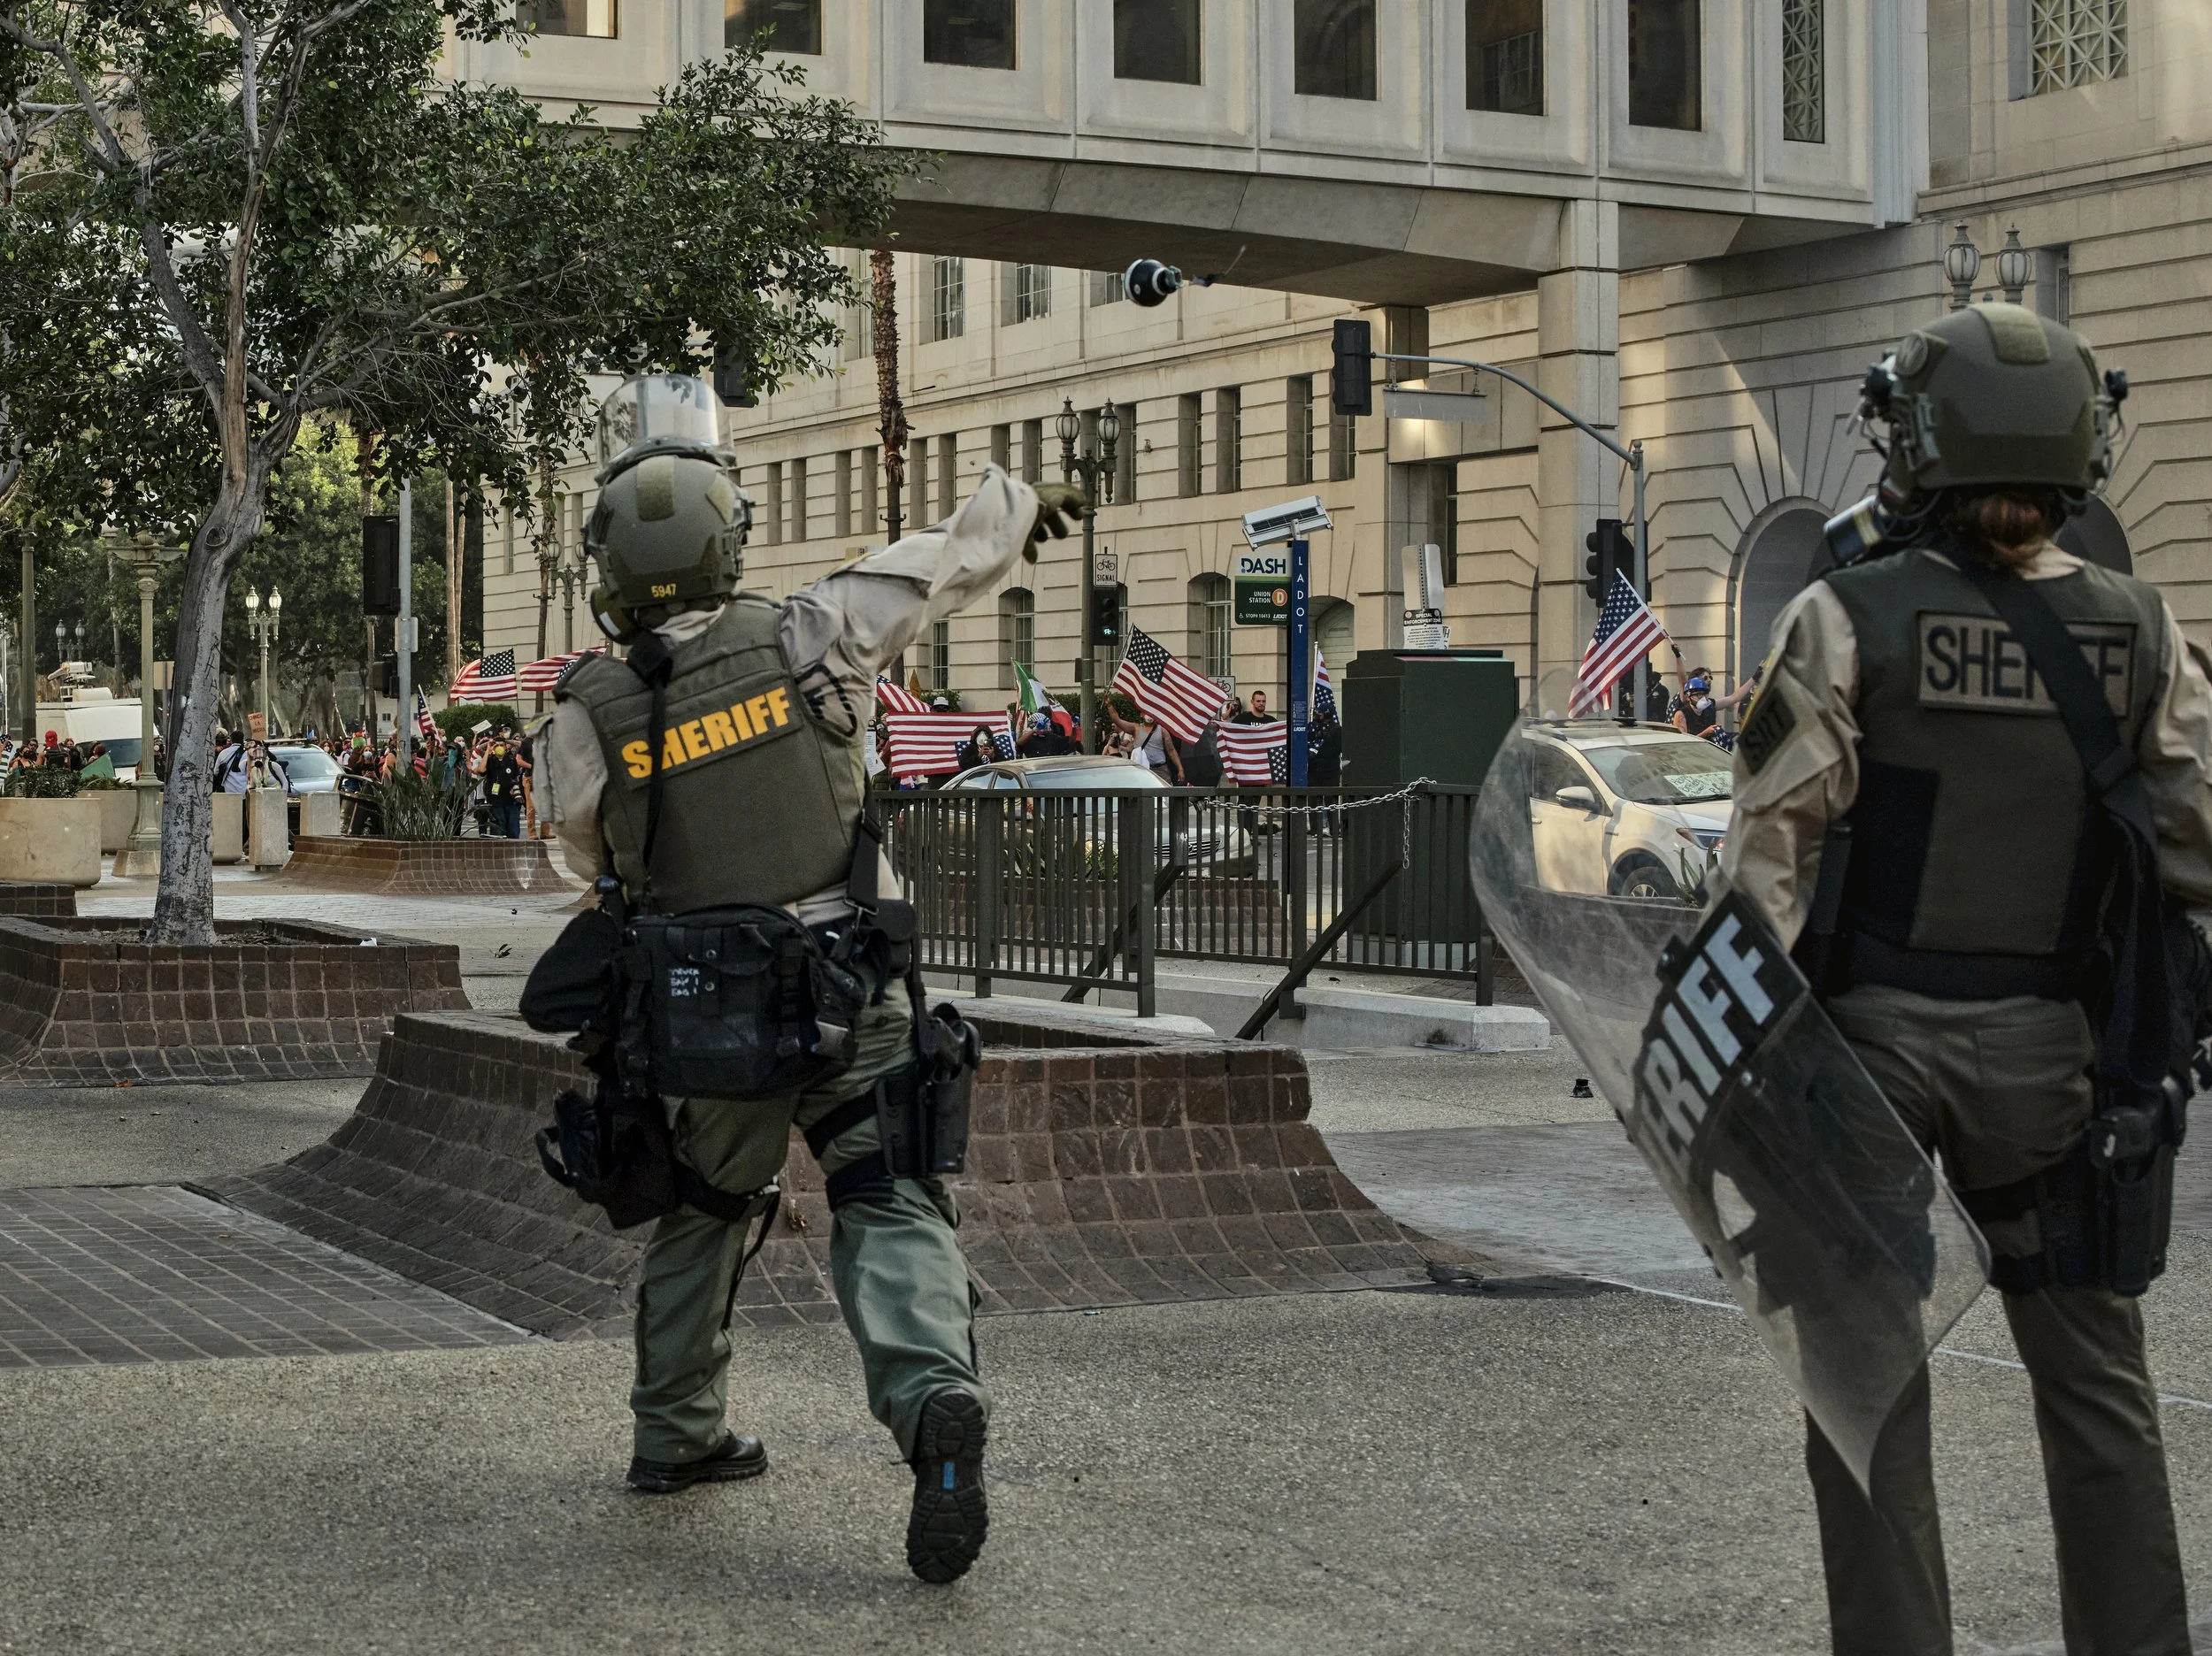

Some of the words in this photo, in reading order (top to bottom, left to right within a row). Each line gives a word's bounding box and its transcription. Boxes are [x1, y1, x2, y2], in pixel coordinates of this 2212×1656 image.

[1241, 558, 1286, 574] DASH
[651, 584, 676, 597] 5947
[1277, 592, 1284, 603] D
[1296, 556, 1305, 634] LADOT
[622, 686, 790, 778] SHERIFF
